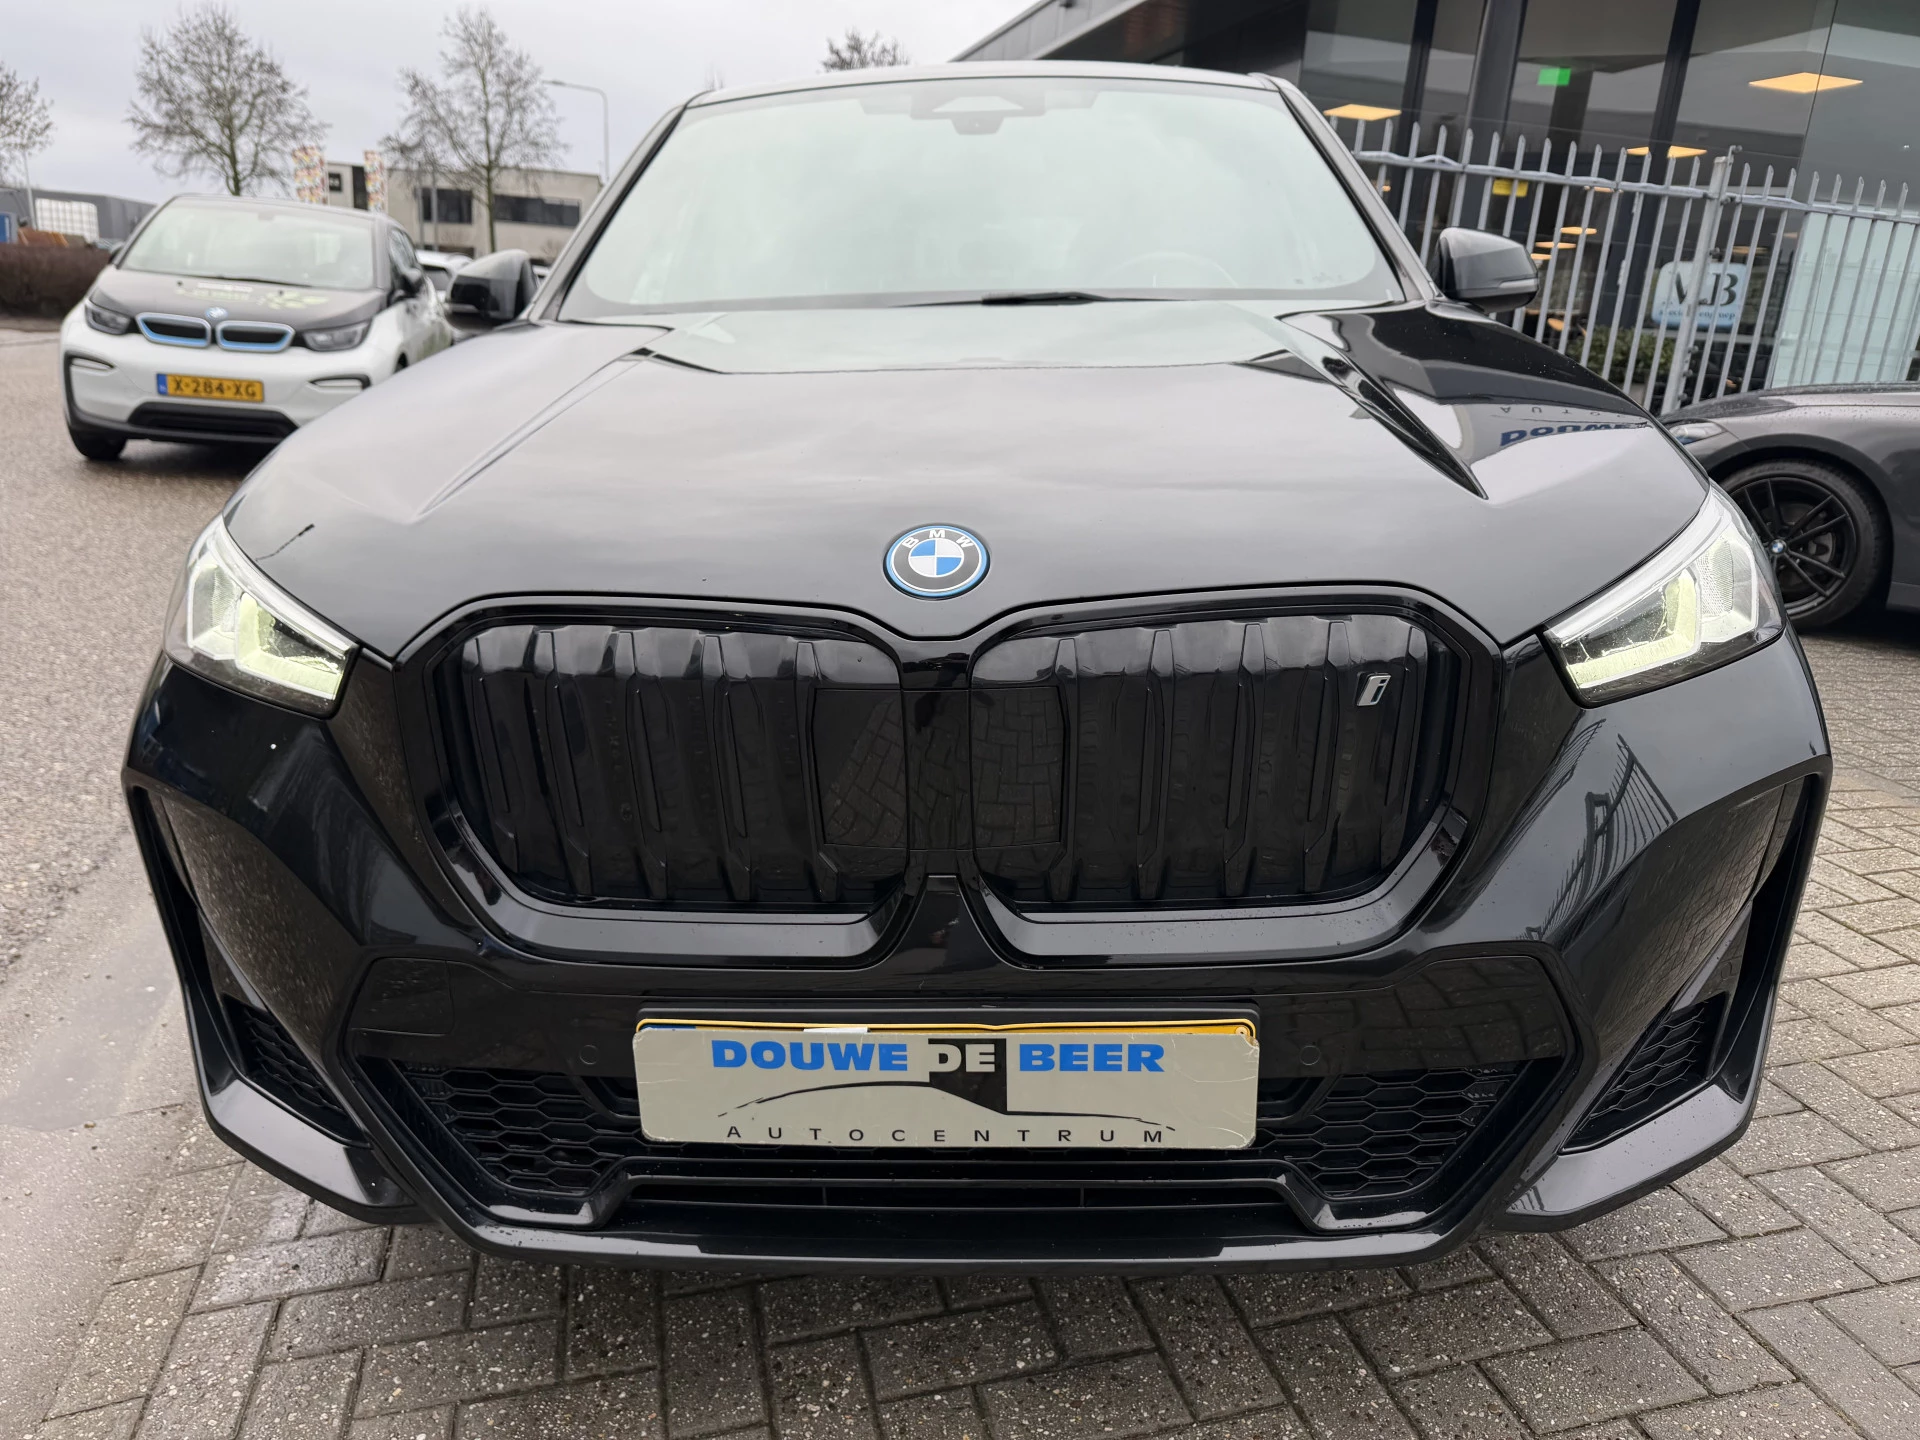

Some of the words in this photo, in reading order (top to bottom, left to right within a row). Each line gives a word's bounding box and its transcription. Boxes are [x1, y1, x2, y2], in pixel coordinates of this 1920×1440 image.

[173, 377, 257, 397] X-284-XG
[901, 529, 975, 549] BMW
[711, 1040, 908, 1072] DOUWE
[927, 1043, 996, 1073] DE
[1019, 1043, 1165, 1073] BEER
[726, 1126, 1162, 1144] AUTOCENTRUM
